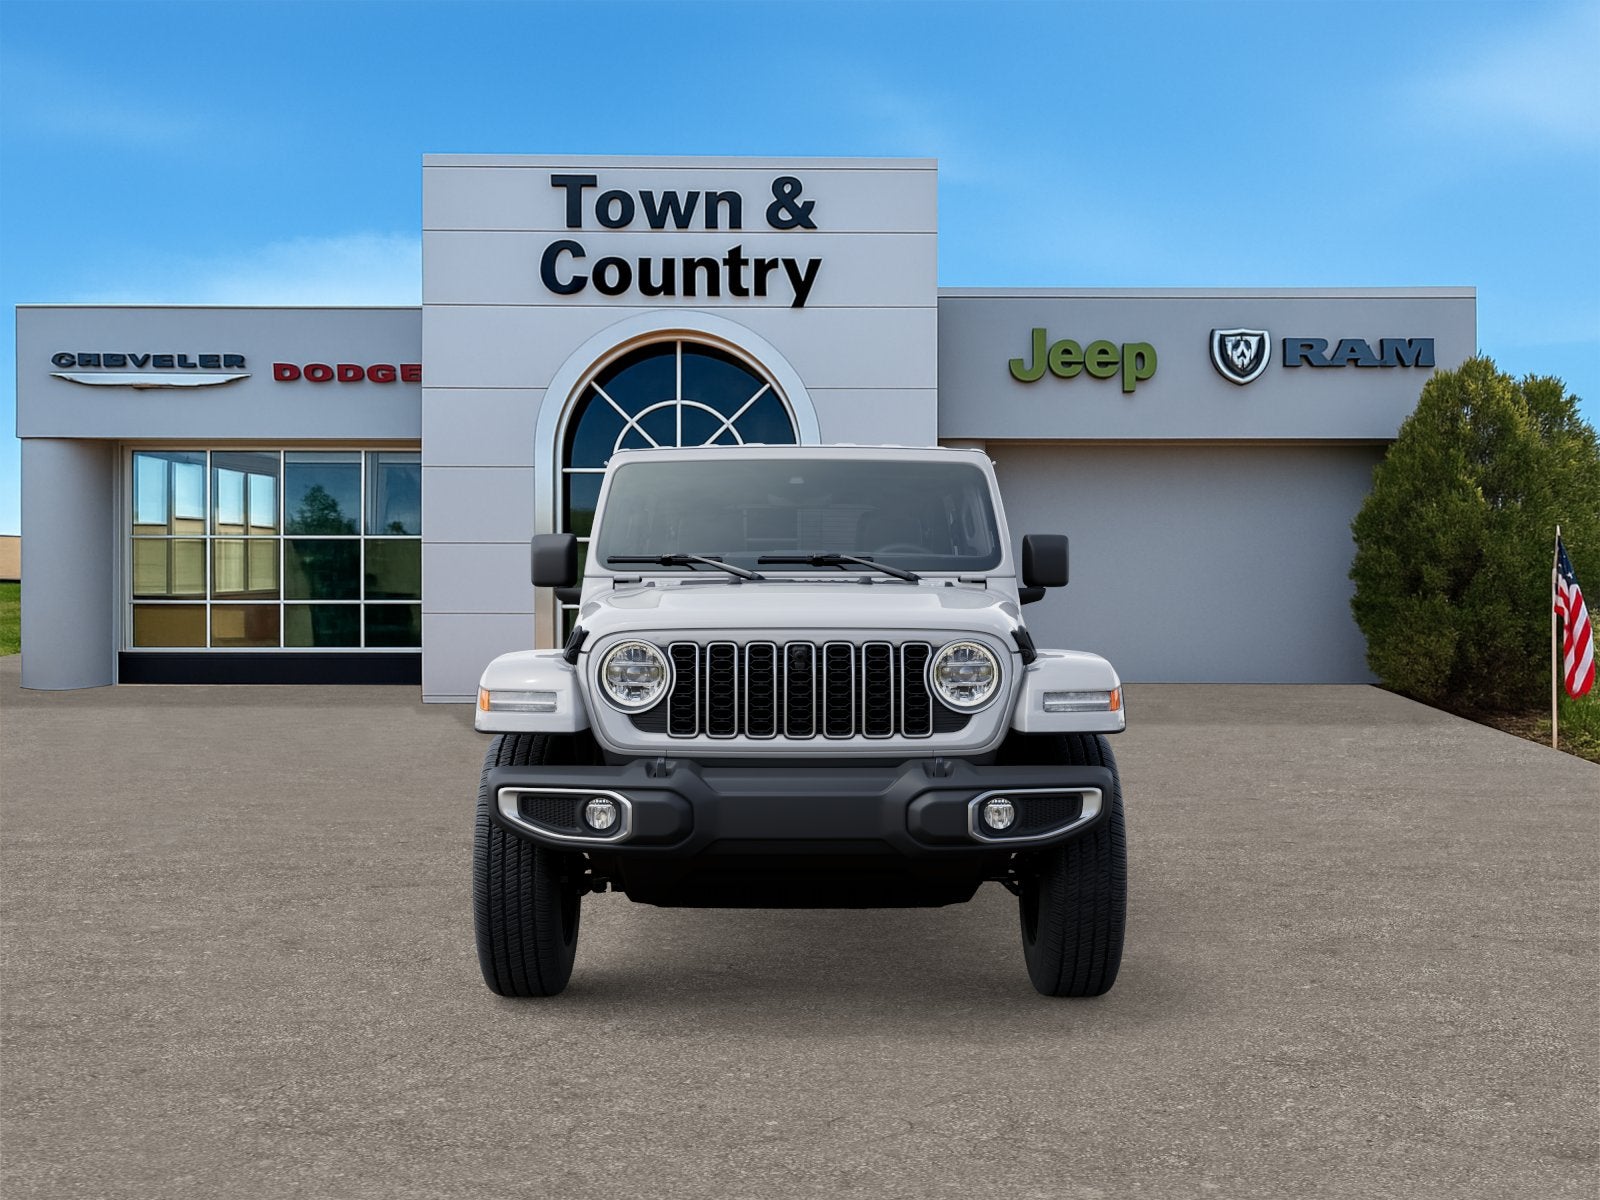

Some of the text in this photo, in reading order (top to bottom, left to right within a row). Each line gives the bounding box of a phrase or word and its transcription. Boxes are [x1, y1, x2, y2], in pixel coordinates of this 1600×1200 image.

[550, 174, 818, 230] Town &
[540, 239, 823, 308] Country
[273, 363, 421, 383] DODGE
[1009, 328, 1157, 392] Jeep
[1283, 337, 1435, 367] RAM
